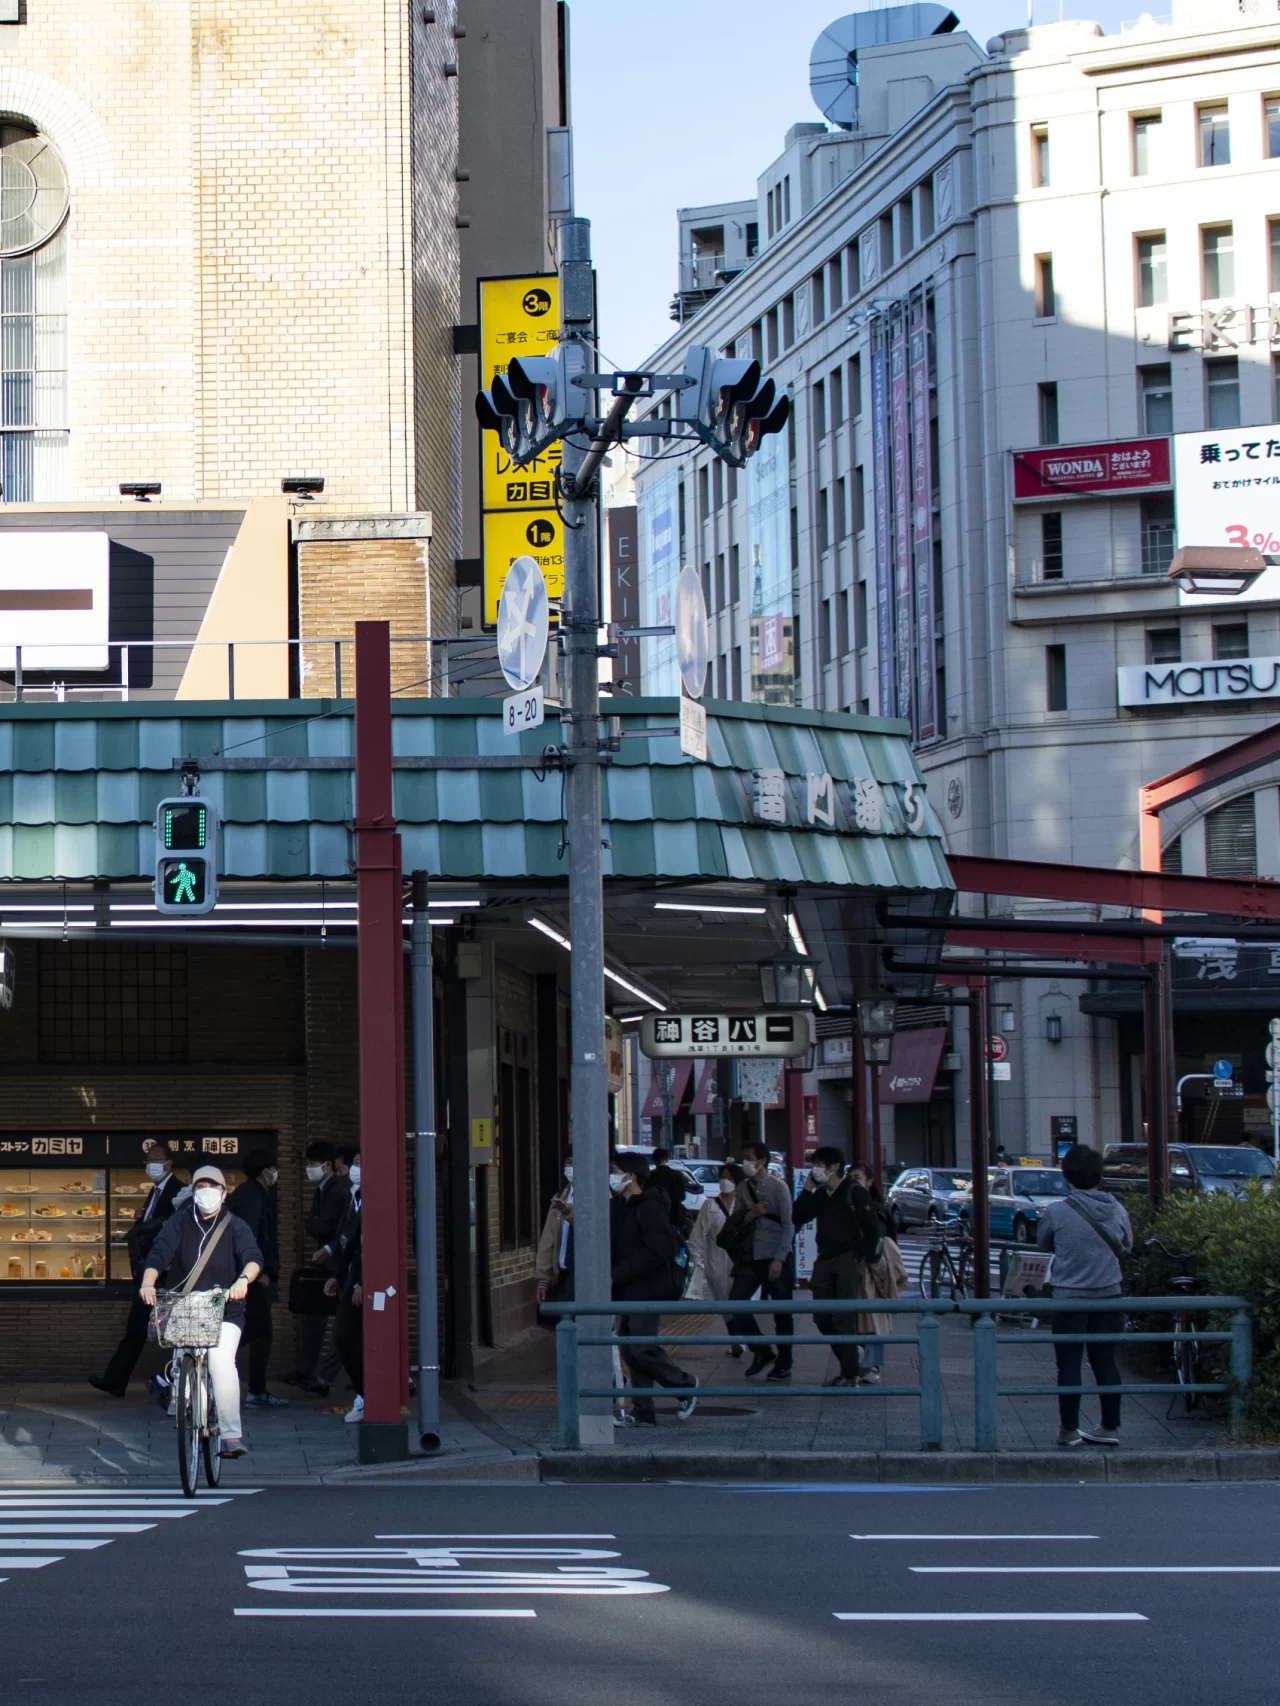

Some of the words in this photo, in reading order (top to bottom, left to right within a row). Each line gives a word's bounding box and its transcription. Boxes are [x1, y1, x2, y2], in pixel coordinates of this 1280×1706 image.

[524, 293, 549, 313] 3階
[495, 328, 562, 345] ご宴会・ご商
[1111, 449, 1151, 462] おはよう
[1047, 458, 1104, 477] WONDA
[507, 481, 562, 502] カミ
[530, 524, 551, 543] 1階
[1145, 662, 1280, 699] MATSU
[508, 697, 538, 727] 8-20
[656, 1018, 792, 1042] 神谷バー
[687, 1044, 761, 1053] 浅草1丁目1番1号
[202, 1137, 239, 1154] 神谷
